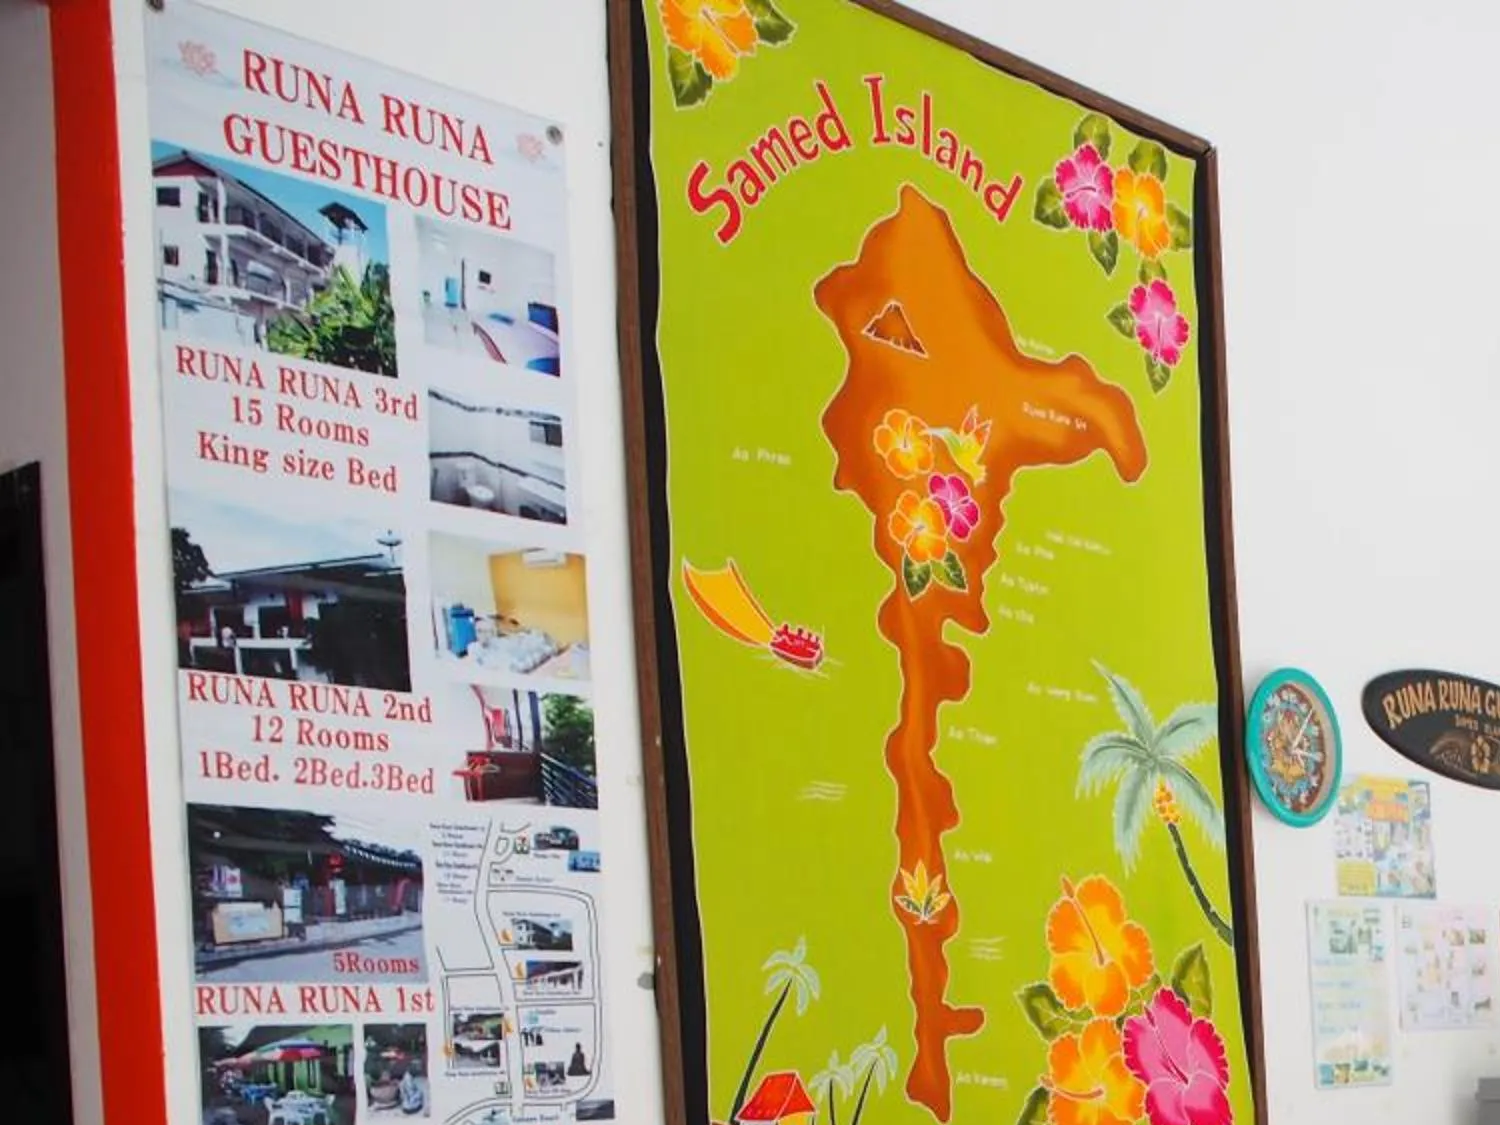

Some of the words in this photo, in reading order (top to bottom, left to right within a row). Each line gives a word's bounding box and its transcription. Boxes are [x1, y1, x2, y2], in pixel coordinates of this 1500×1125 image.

[243, 48, 364, 126] RUNA
[381, 93, 493, 164] RUNA
[223, 113, 512, 231] GUESTHOUSE
[687, 79, 852, 246] Samed
[863, 74, 1023, 224] Island
[176, 346, 264, 389] RUNA
[279, 365, 361, 407] RUNA
[375, 387, 418, 420] 3rd
[231, 396, 262, 425] 15
[277, 404, 370, 446] Rooms
[197, 432, 268, 472] King
[283, 450, 334, 480] size
[347, 458, 398, 492] Bed
[188, 673, 276, 707] RUNA
[288, 684, 371, 717] RUNA
[384, 694, 432, 723] 2nd
[1382, 681, 1436, 729] RUNA
[1437, 678, 1481, 714] RUNA
[251, 716, 283, 743] 12
[297, 721, 389, 752] Rooms
[200, 751, 279, 783] 1Bed.
[333, 952, 420, 974] 5Rooms
[196, 986, 285, 1015] RUNA
[300, 985, 384, 1013] RUNA
[398, 987, 434, 1013] 1st
